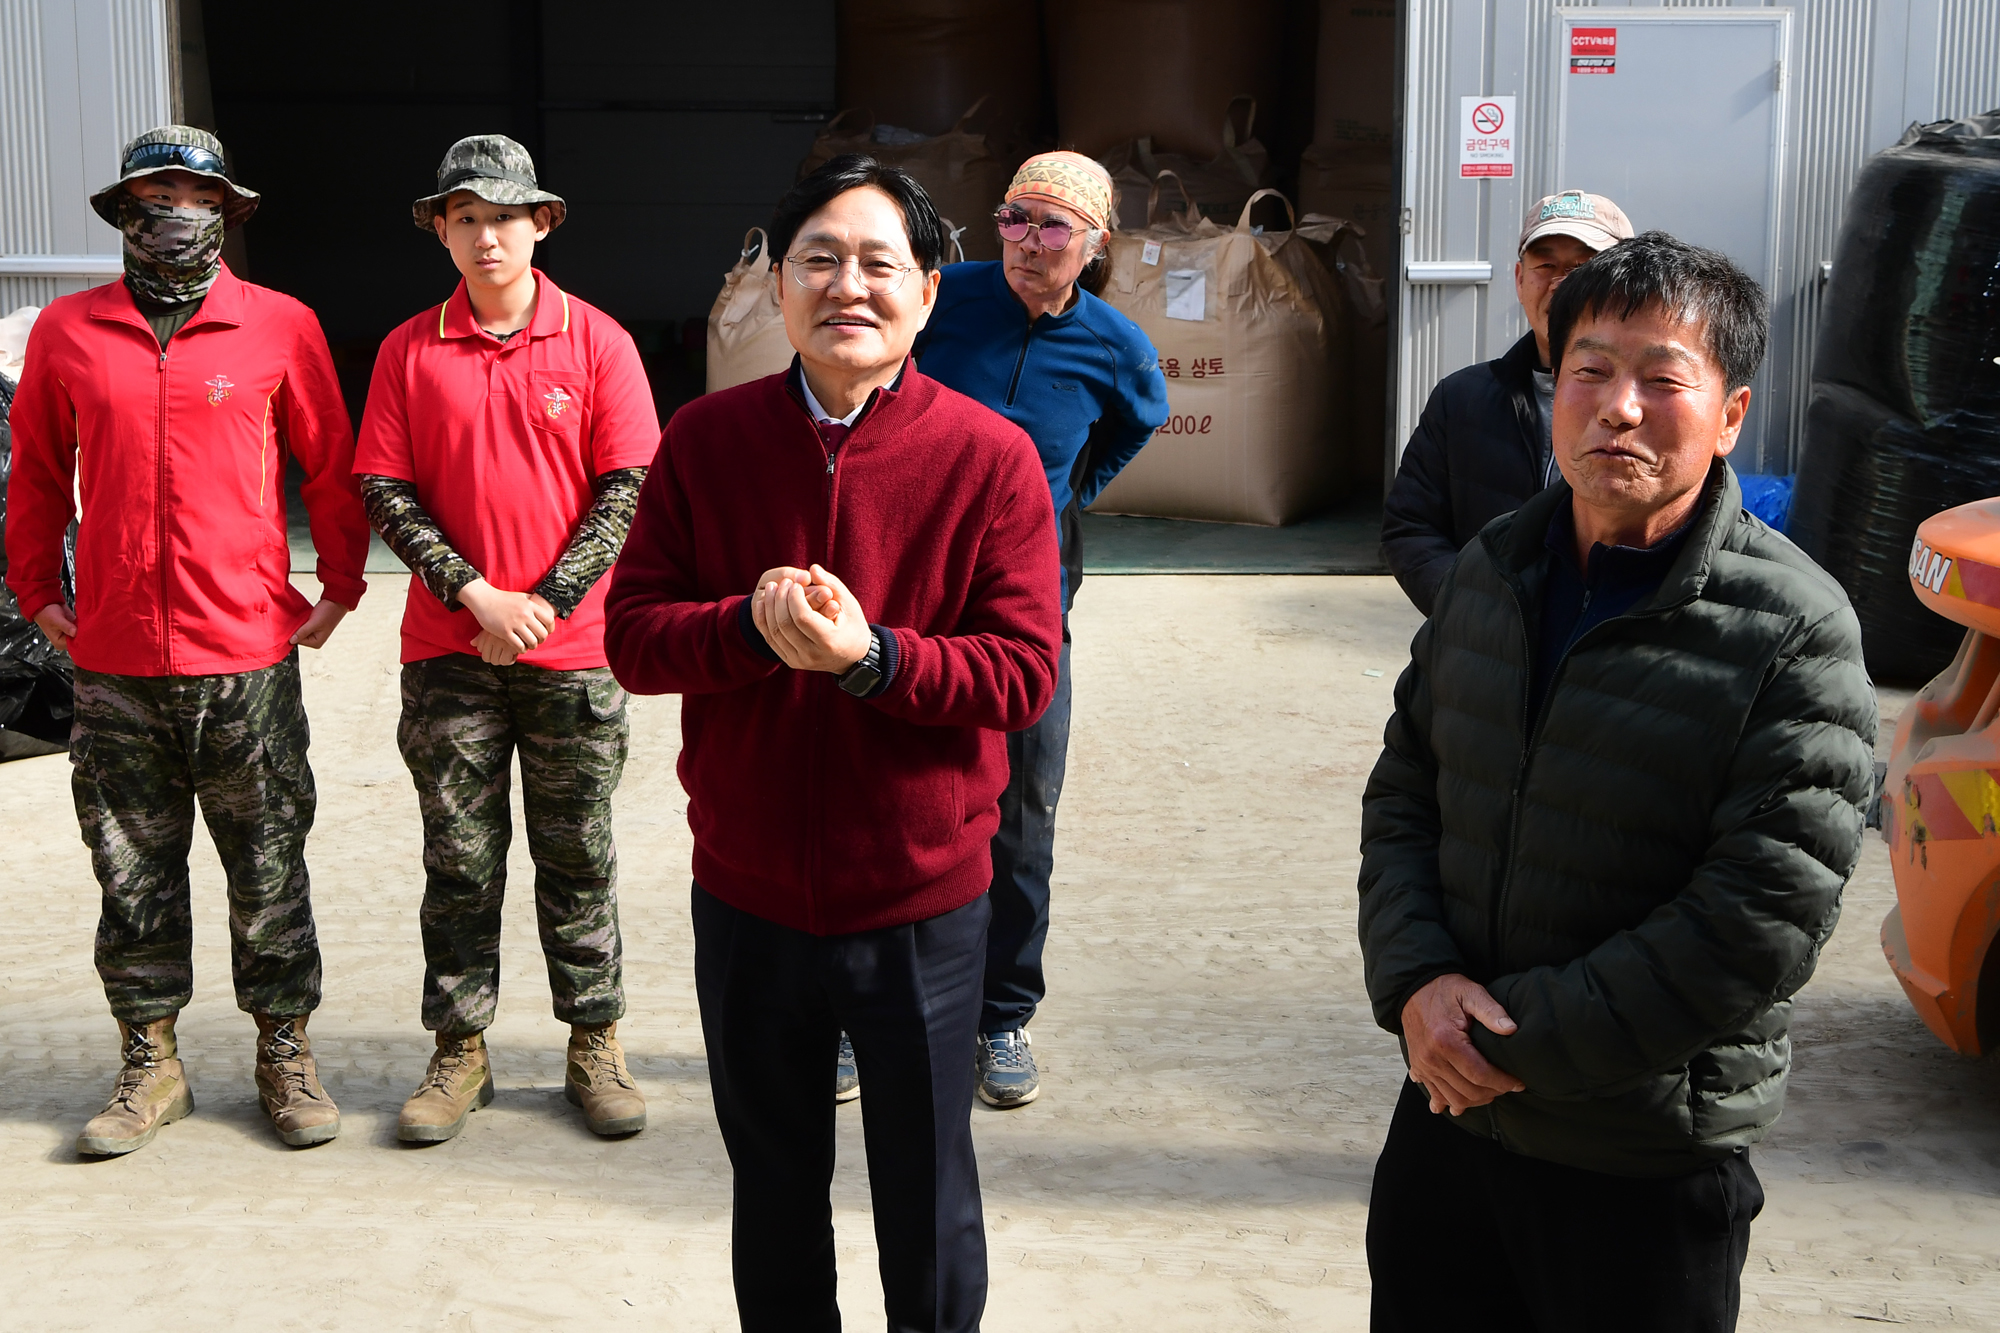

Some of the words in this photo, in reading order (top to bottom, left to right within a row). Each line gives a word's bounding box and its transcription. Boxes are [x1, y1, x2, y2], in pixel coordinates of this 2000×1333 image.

[1466, 138, 1510, 151] 금연구역
[1540, 201, 1595, 217] YOSEMITE
[1191, 358, 1225, 378] 상토
